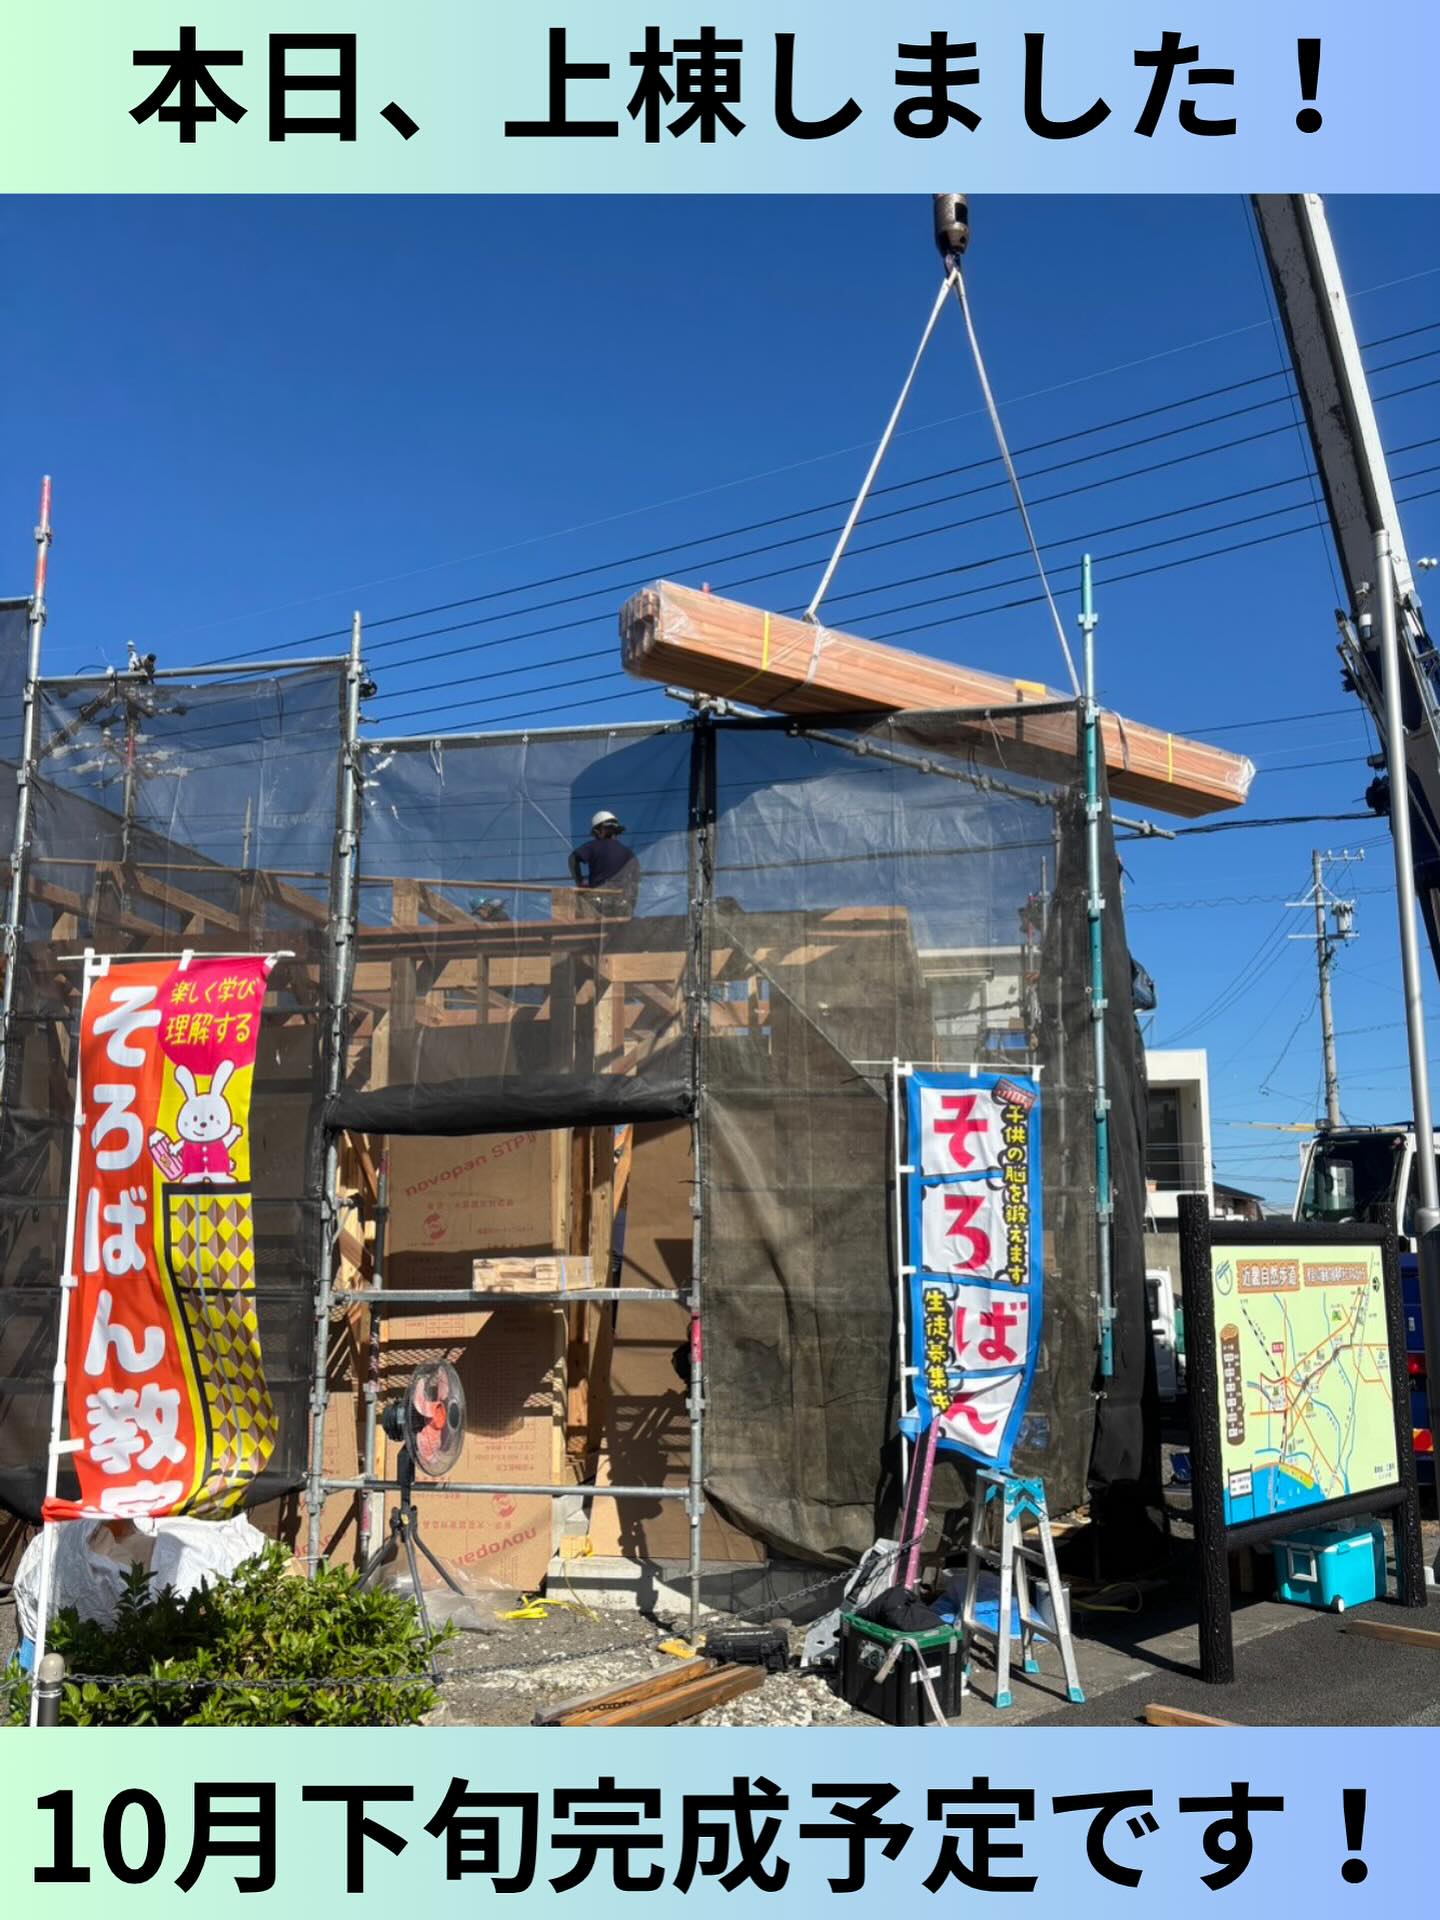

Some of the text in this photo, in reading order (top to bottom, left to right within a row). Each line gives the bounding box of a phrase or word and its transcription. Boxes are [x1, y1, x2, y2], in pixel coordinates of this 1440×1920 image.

[164, 1012, 253, 1046] 理解する
[170, 975, 261, 1004] 楽しく学び
[405, 1155, 487, 1197] novopan
[1004, 1104, 1028, 1285] 子供の脳を鍛えます
[933, 1094, 1029, 1436] そろばん
[924, 1289, 950, 1411] 生徒募集中
